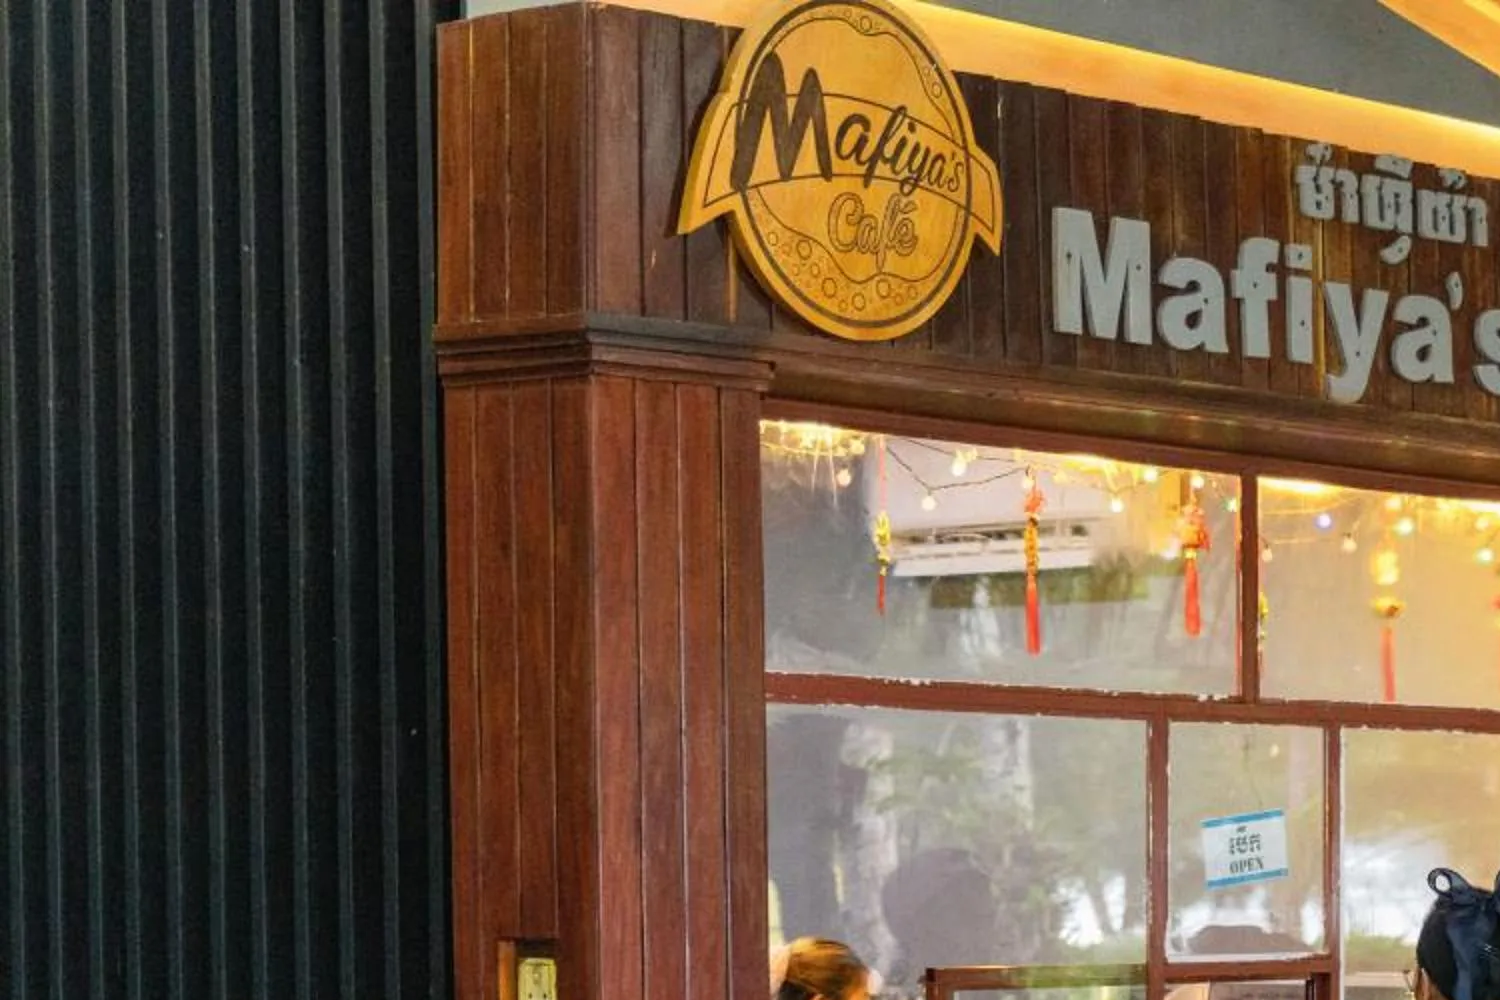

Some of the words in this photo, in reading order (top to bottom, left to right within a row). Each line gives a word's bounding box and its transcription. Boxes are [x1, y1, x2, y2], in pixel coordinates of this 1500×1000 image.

[730, 51, 964, 196] Mafiya's
[827, 191, 918, 273] Café
[1229, 857, 1264, 874] OPEN
